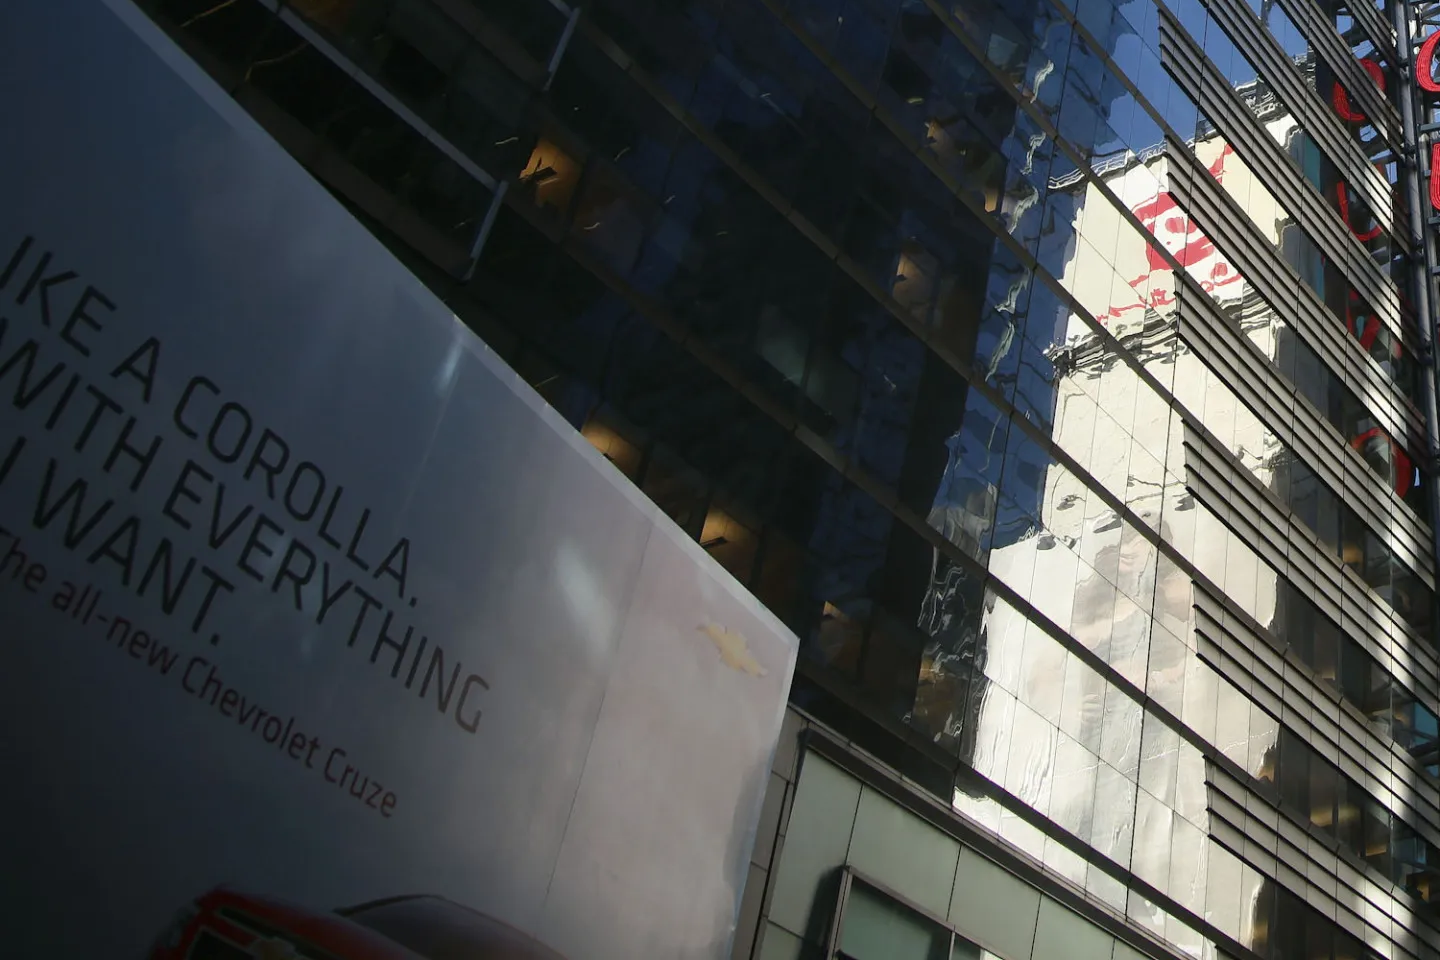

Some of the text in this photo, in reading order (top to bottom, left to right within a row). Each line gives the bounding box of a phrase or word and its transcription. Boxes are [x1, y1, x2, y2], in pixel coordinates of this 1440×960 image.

[0, 317, 490, 734] WITH EVERYTHING
[32, 457, 235, 646] WANT.
[109, 336, 161, 404] A
[174, 376, 417, 607] COROLLA.
[52, 580, 179, 676] all-new
[181, 656, 321, 769] Chevrolet
[323, 748, 397, 818] Cruze
